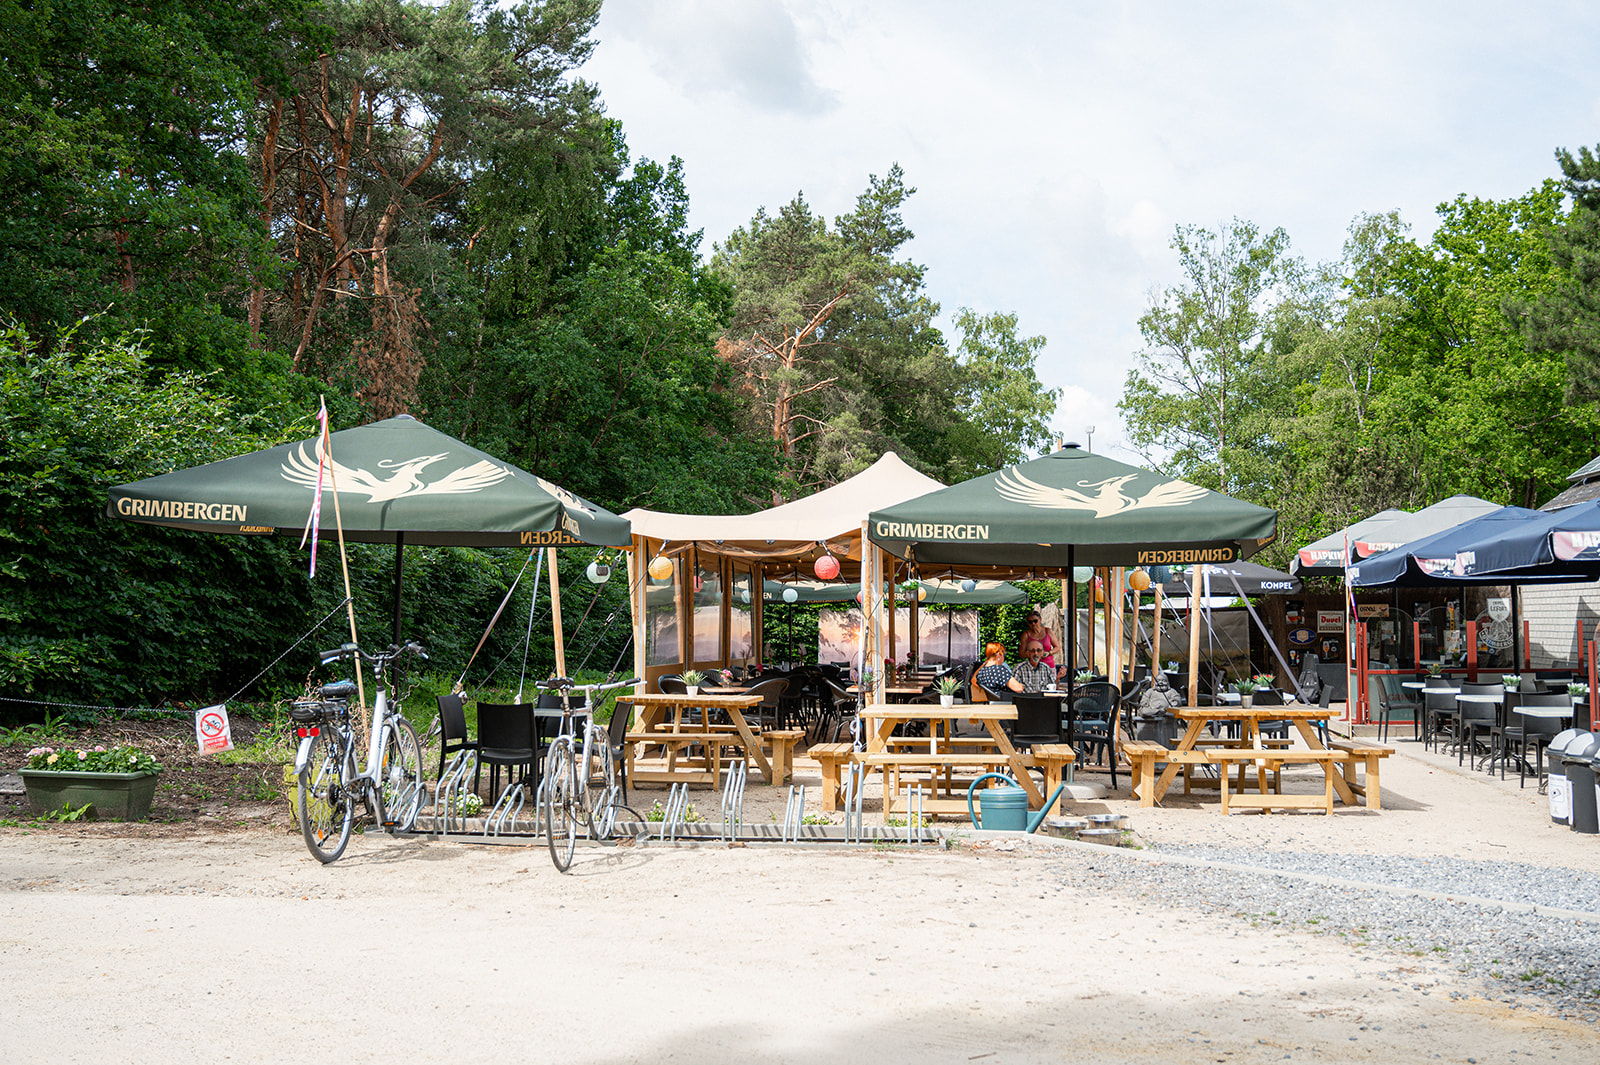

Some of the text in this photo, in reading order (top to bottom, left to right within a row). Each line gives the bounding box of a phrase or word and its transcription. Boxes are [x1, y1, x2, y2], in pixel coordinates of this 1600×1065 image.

[117, 497, 247, 521] GRIMBERGEN
[876, 521, 989, 539] GRIMBERGEN
[1260, 581, 1293, 590] KOMPEL
